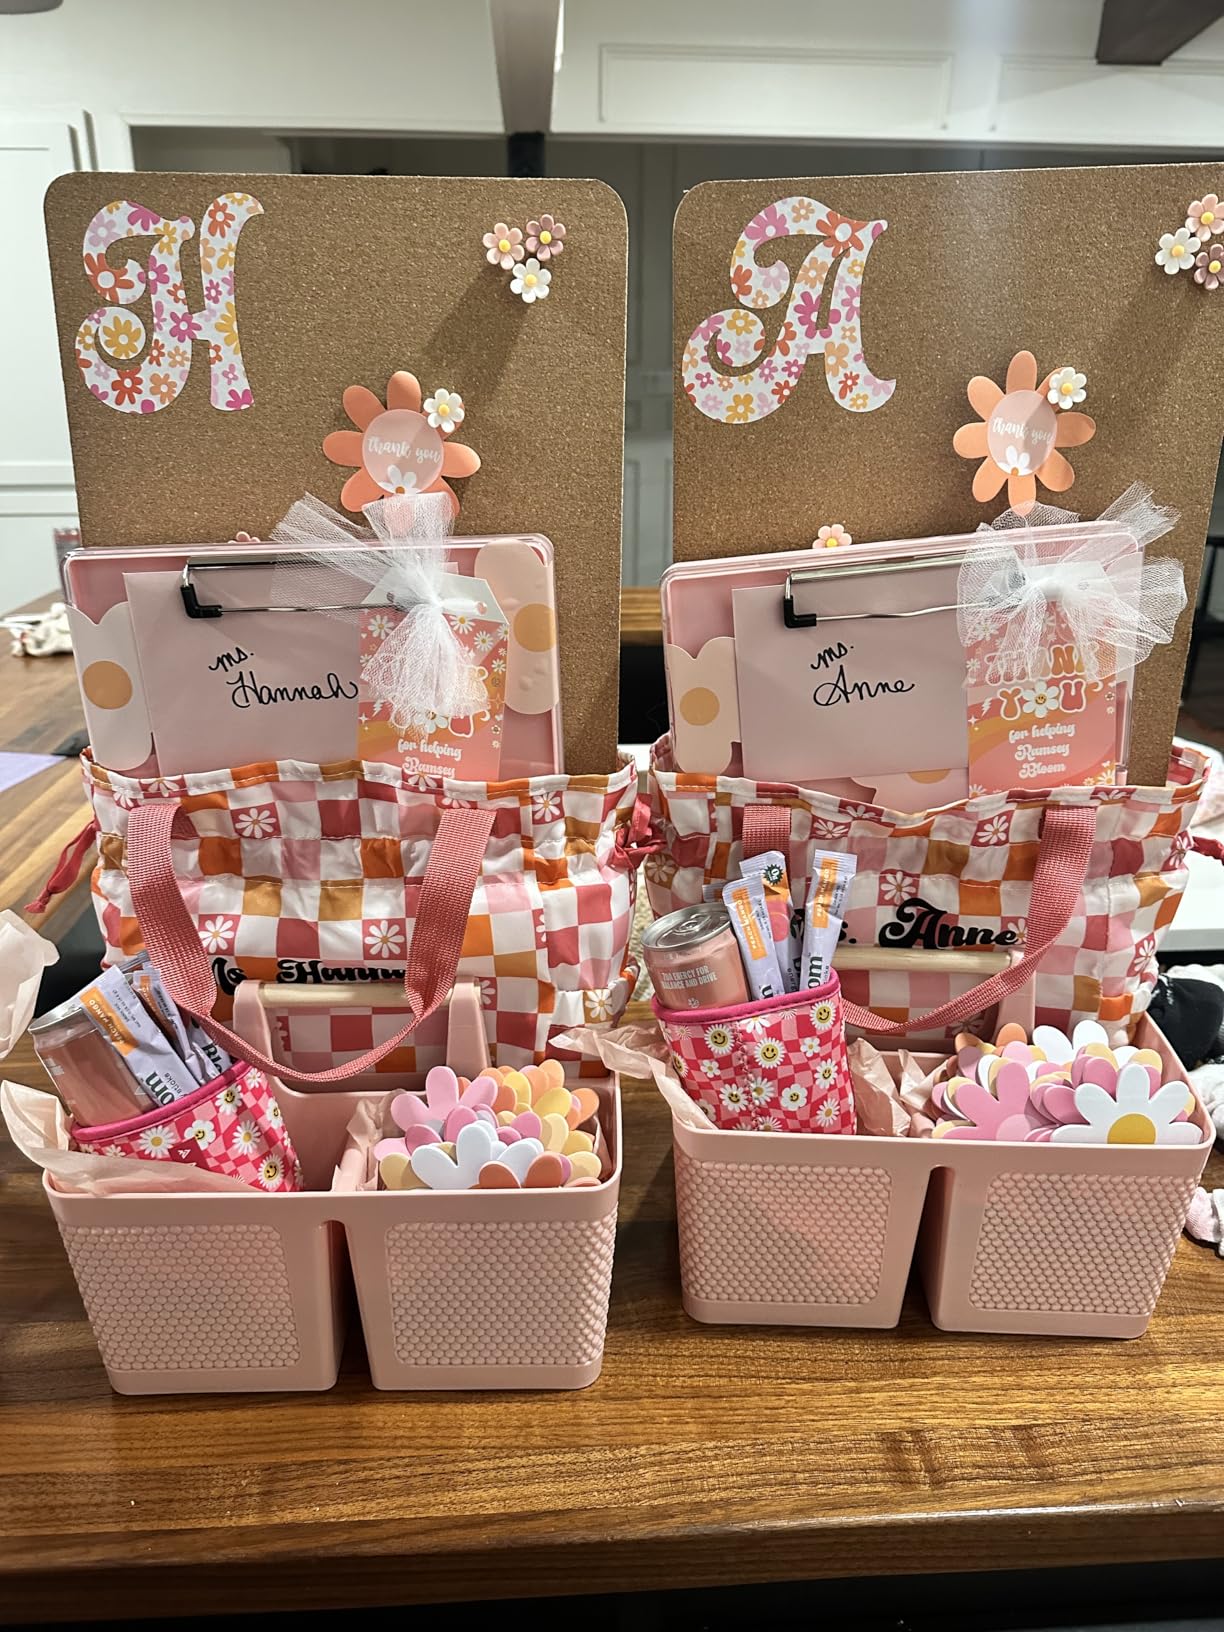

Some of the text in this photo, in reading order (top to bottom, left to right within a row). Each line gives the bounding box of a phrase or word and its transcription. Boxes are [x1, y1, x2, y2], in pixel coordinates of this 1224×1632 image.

[75, 192, 265, 414] H
[682, 197, 896, 424] A
[992, 417, 1055, 445] thank you
[368, 436, 440, 463] thank you
[226, 671, 359, 708] Hannah
[813, 664, 916, 706] Anne
[1008, 723, 1076, 743] for helping
[398, 738, 462, 761] for helping
[1014, 743, 1070, 761] Ramsey
[402, 756, 456, 780] Ramsey
[1019, 762, 1066, 779] Bloom
[878, 897, 1019, 950] Anne
[696, 965, 710, 976] FOR
[699, 972, 719, 985] DRIVE
[162, 1071, 182, 1095] sticks
